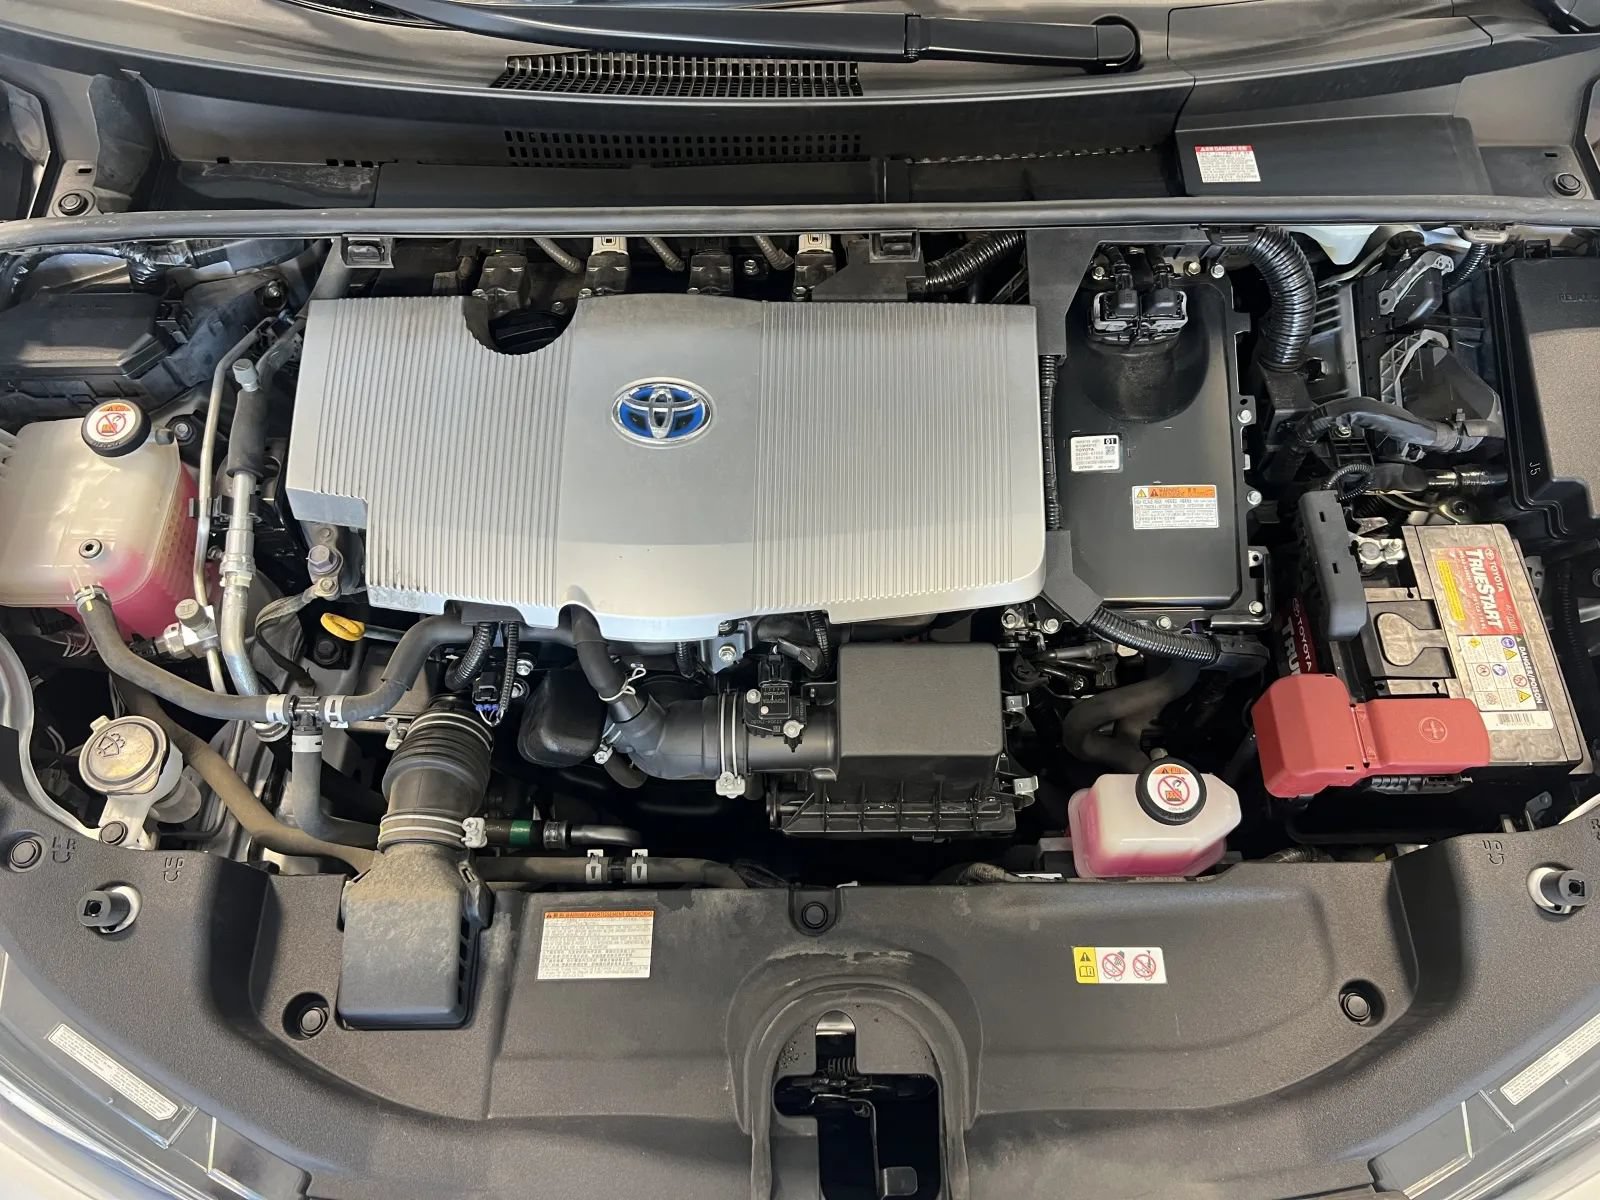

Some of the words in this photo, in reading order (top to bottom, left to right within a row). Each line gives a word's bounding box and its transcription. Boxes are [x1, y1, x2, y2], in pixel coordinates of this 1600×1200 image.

[1490, 562, 1505, 593] TOYOTA
[1297, 617, 1312, 672] TOYOTA
[1518, 646, 1543, 704] DANGER/POISON
